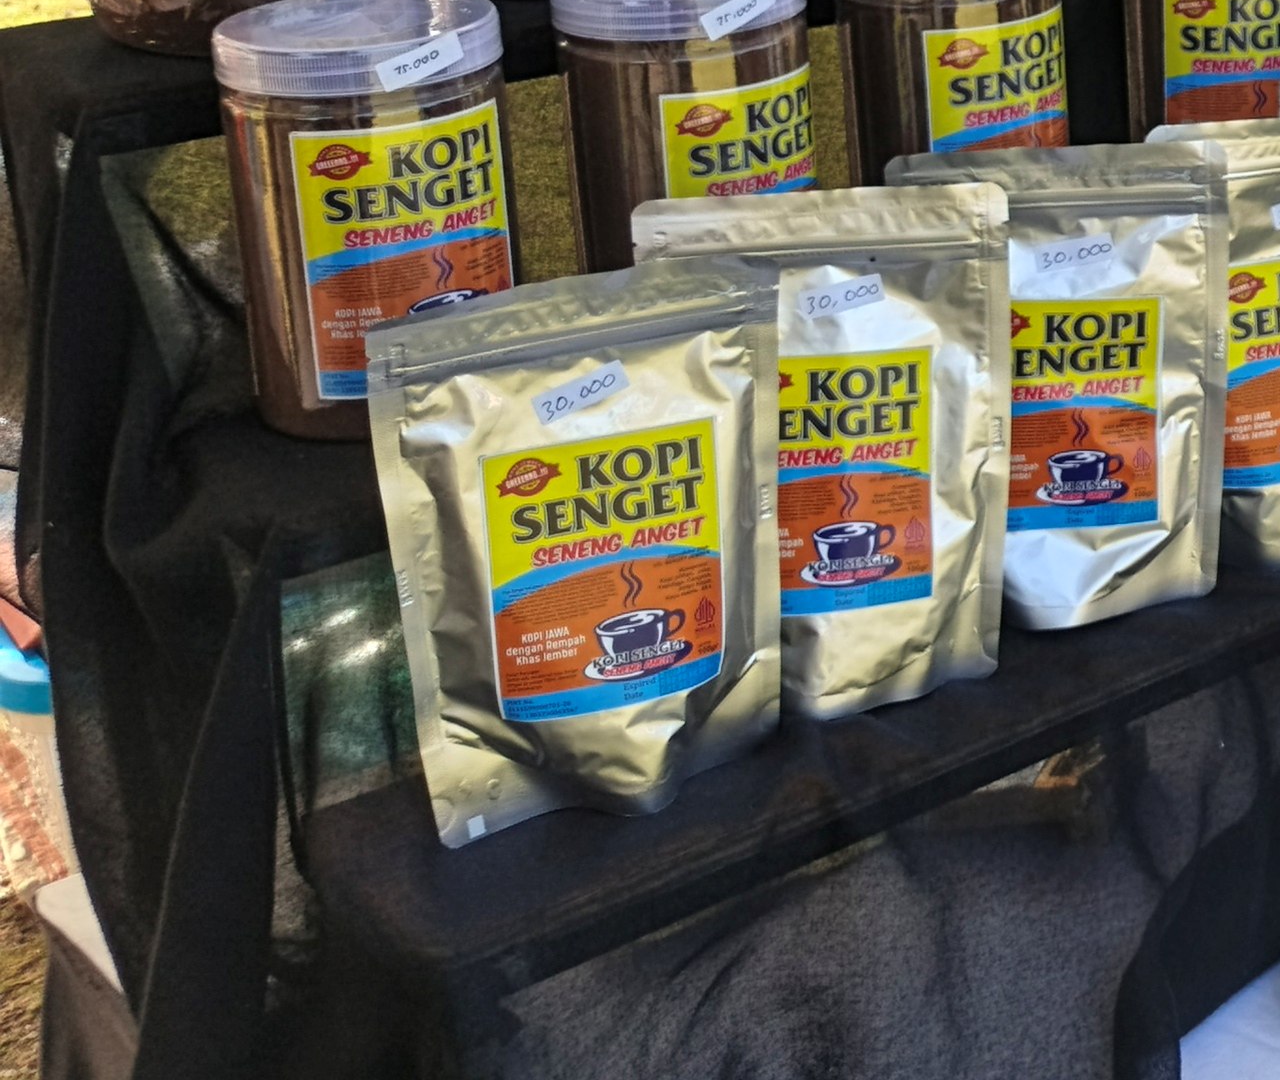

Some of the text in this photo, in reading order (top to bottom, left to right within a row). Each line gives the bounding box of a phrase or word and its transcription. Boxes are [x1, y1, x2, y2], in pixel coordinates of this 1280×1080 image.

[1001, 19, 1063, 67] KOPI
[950, 51, 1063, 106] SENGET
[1192, 58, 1256, 74] SENENG
[744, 85, 811, 135] KOPI
[965, 89, 1063, 128] SENENG ANGE
[388, 123, 493, 179] KOPI
[322, 159, 493, 224] SENGET
[706, 159, 814, 197] SENENG ANGE
[344, 198, 497, 250] SENENG ANGET
[1043, 310, 1150, 345] KOPI
[1012, 341, 1149, 379] ENGET
[806, 361, 922, 404] KOPI
[1012, 375, 1145, 401] ENENG ANGET
[779, 397, 921, 442] ENGET
[575, 434, 702, 493] KOPI
[778, 438, 918, 469] ENENG ANGET
[511, 474, 704, 545] SENGET
[532, 516, 706, 568] SENENG ANGET
[506, 634, 586, 658] dengan Rempah
[521, 626, 570, 643] KOPI JAWA
[516, 648, 578, 665] Khas Jember
